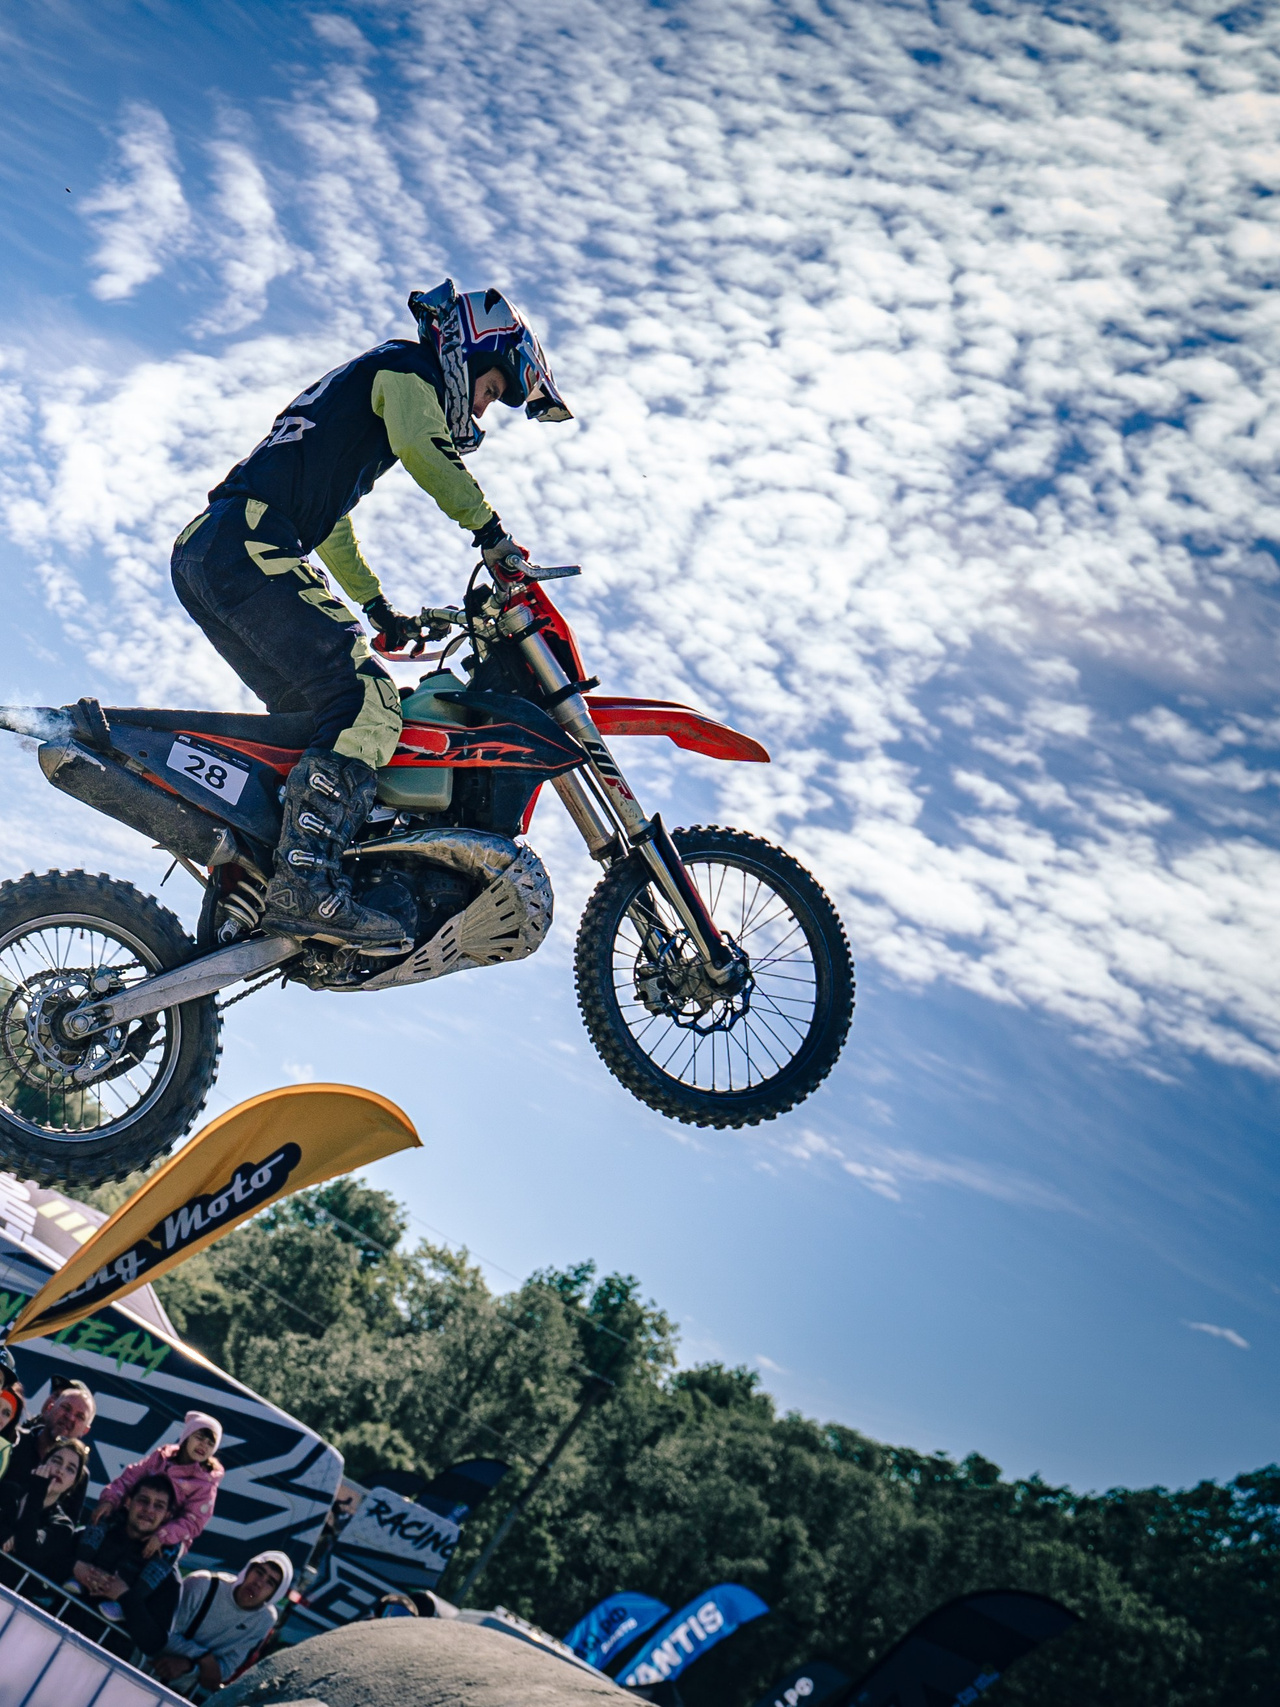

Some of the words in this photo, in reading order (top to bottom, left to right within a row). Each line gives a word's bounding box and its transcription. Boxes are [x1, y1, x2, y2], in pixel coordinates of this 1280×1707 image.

[184, 754, 228, 790] 28
[164, 1153, 285, 1250] Moto
[51, 1317, 172, 1379] TEAM
